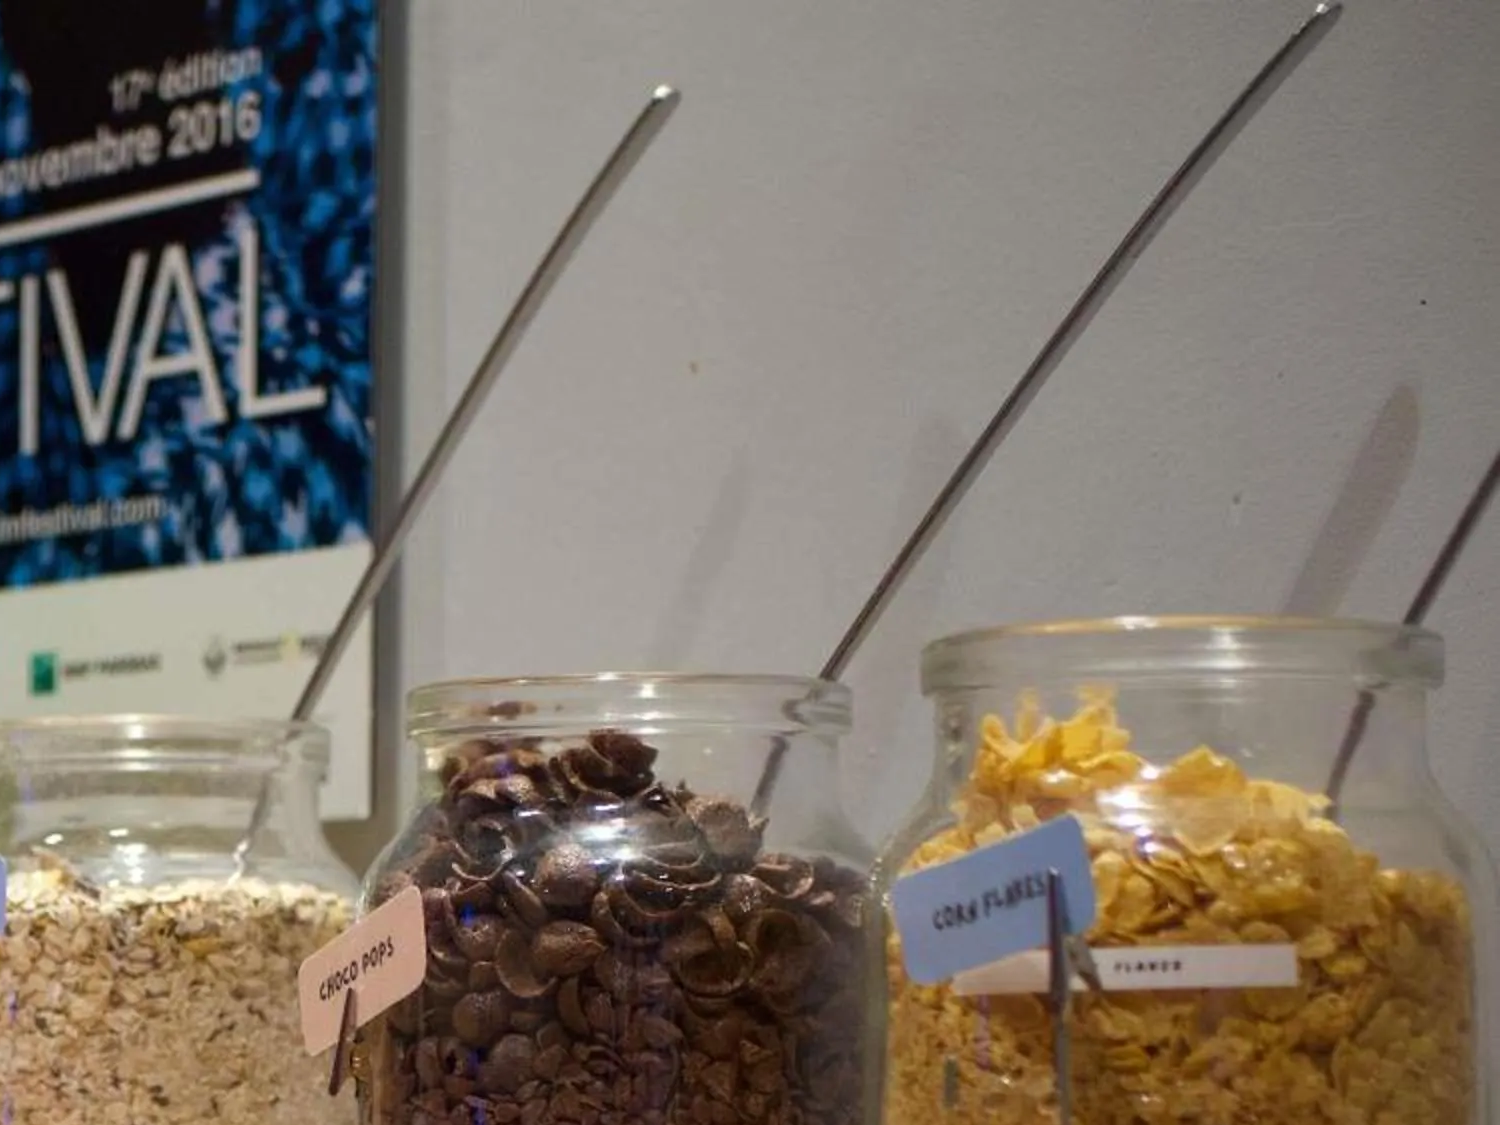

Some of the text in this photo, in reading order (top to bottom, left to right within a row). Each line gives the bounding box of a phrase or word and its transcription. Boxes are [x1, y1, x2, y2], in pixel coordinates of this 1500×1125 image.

[167, 90, 261, 158] 2016
[932, 898, 978, 931] CORN
[319, 936, 395, 1001] CHOCO POPS
